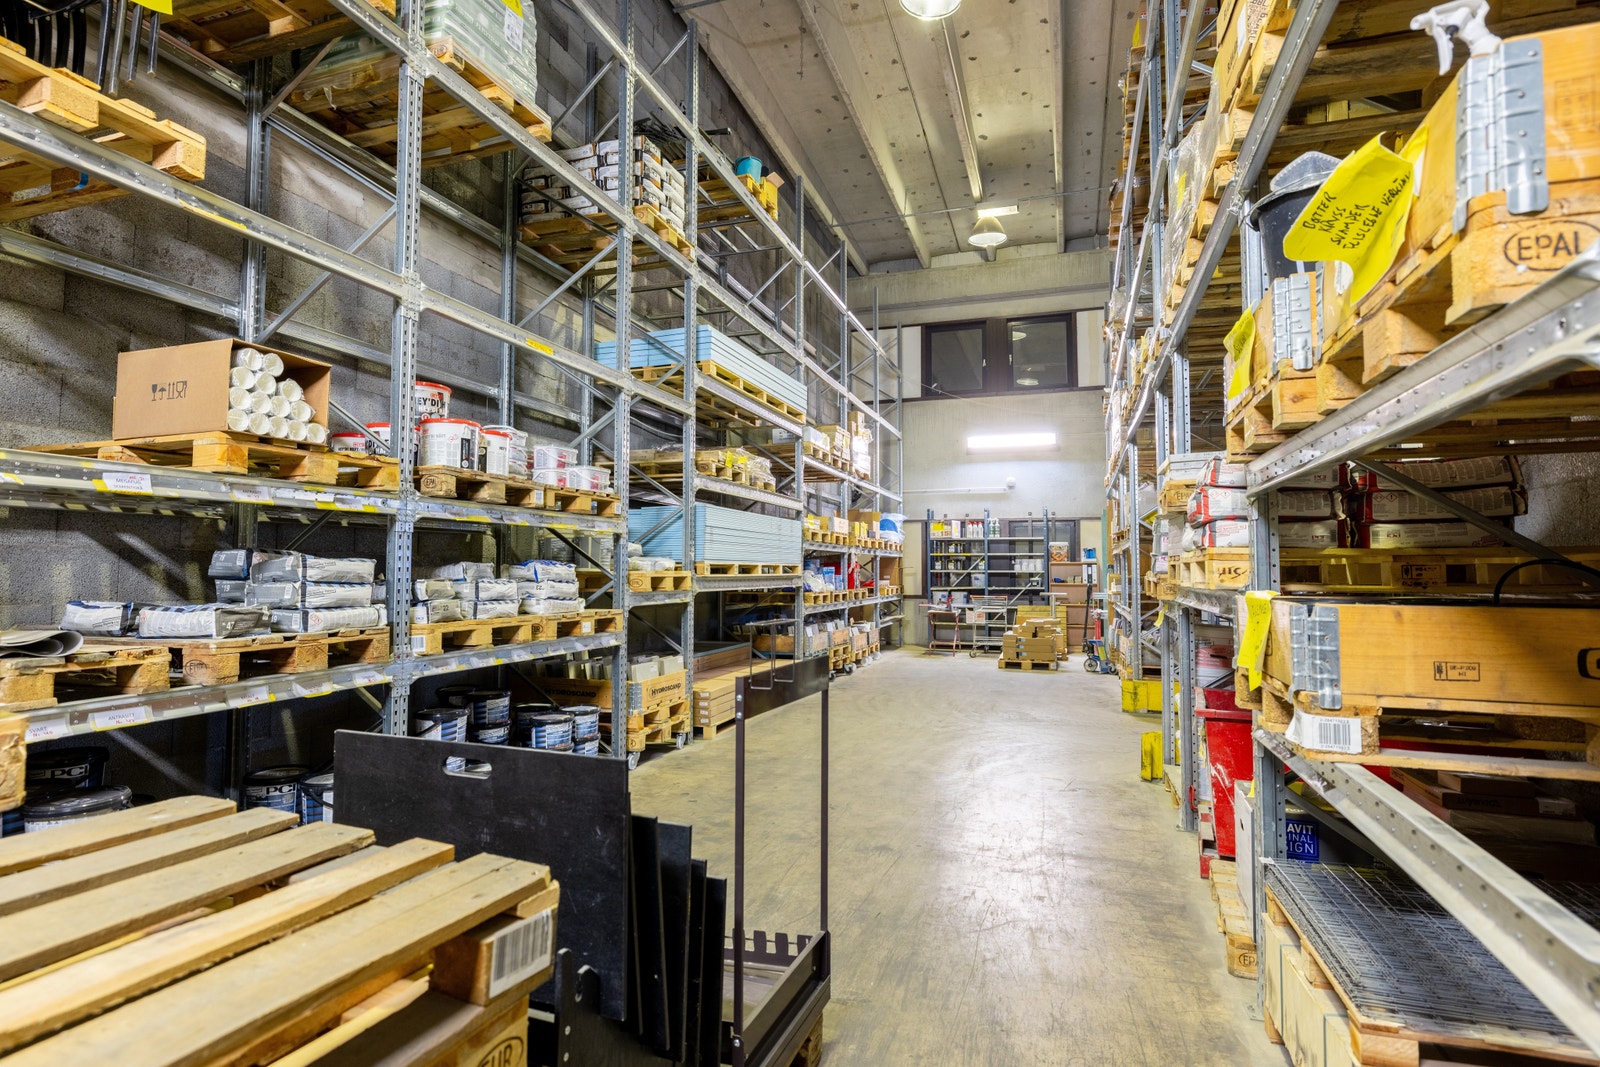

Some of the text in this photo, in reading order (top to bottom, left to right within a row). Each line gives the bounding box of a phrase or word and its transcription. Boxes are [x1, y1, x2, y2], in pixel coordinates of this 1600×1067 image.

[1517, 231, 1581, 260] EPAL
[651, 682, 682, 696] HYDROSCAND
[50, 764, 88, 779] PCI
[266, 783, 296, 795] PCI
[1286, 833, 1313, 843] INAL
[1243, 955, 1257, 967] EP
